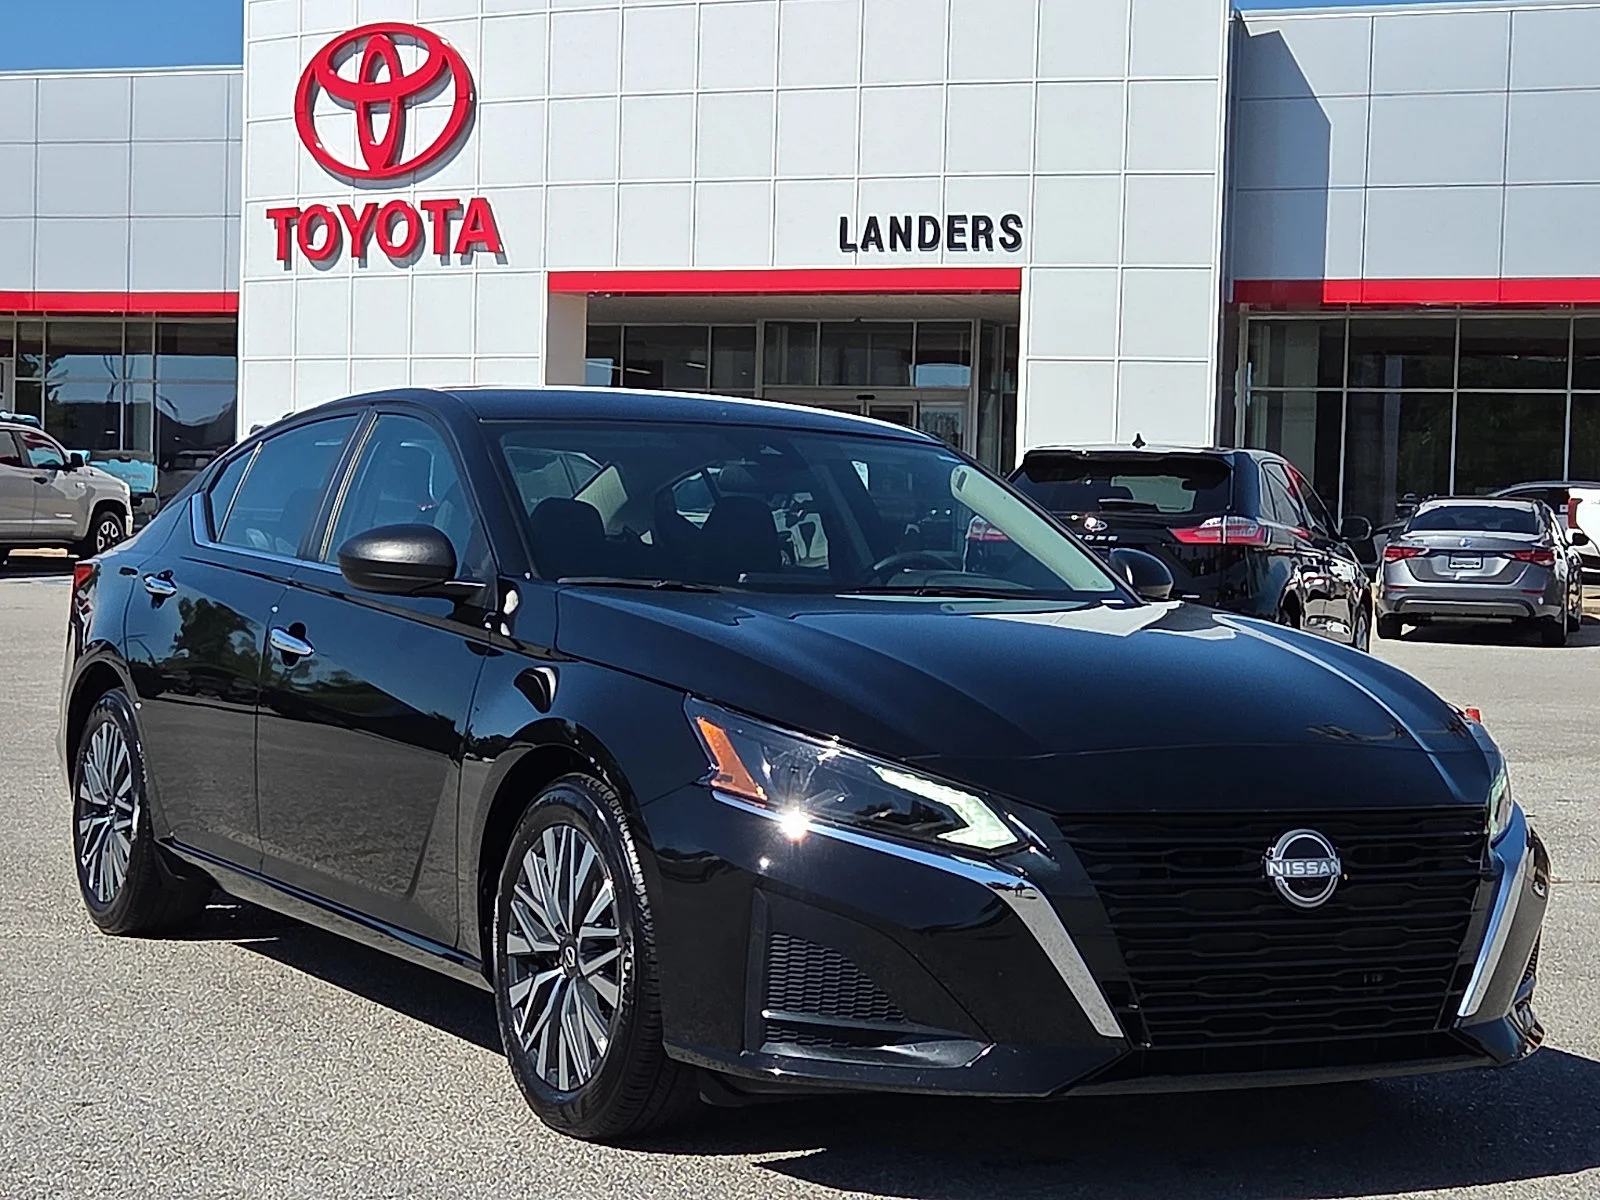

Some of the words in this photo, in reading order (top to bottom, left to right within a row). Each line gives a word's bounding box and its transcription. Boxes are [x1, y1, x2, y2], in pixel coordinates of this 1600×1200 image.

[266, 197, 503, 261] TOYOTA
[839, 213, 1024, 252] LANDERS
[1269, 860, 1340, 875] NISSAN
